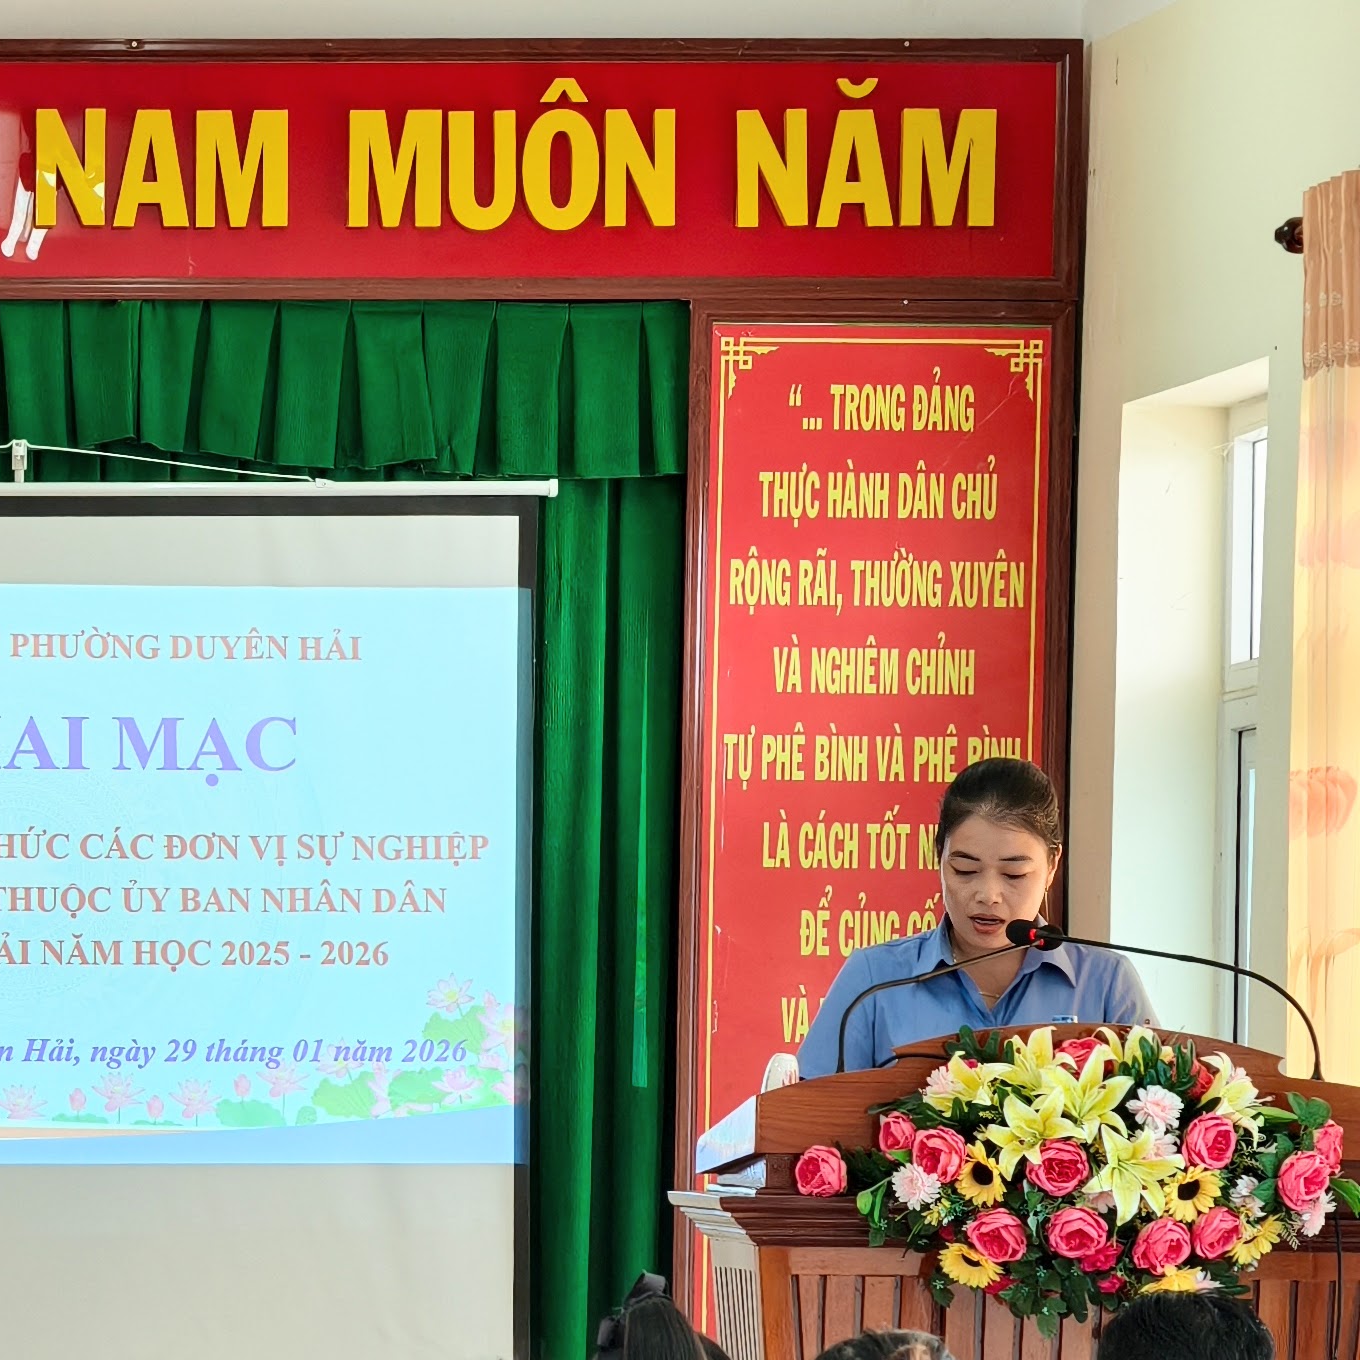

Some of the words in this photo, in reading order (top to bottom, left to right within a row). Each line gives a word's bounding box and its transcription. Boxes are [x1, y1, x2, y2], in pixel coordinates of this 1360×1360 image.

[36, 109, 288, 228] NAM
[349, 78, 676, 230] MUÔN
[737, 78, 998, 228] NĂM
[831, 384, 905, 431] TRONG
[913, 367, 974, 431] ĐẢNG
[759, 463, 820, 528] THỰC
[828, 459, 889, 518] HÀNH
[898, 460, 944, 518] DÂN
[952, 455, 997, 520] CHỦ
[730, 546, 791, 615] RỘNG
[798, 548, 842, 615] RÃI,
[851, 548, 942, 607] THƯỜNG
[949, 549, 1024, 608] XUYÊN
[10, 626, 160, 659] PHƯỜNG
[170, 627, 288, 660] DUYÊN
[298, 628, 362, 660] HẢI
[773, 634, 802, 693] VÀ
[811, 635, 899, 694] NGHIÊM
[906, 632, 975, 695] CHỈNH
[112, 717, 296, 786] MẠC
[724, 725, 755, 790] TỰ
[762, 722, 805, 780] PHÊ
[815, 723, 868, 781] BÌNH
[876, 723, 904, 781] VÀ
[914, 724, 957, 782] PHÊ
[80, 826, 153, 860] CÁC
[164, 832, 240, 860] ĐƠN
[248, 834, 287, 867] VỊ
[297, 831, 344, 866] SỰ
[352, 832, 489, 867] NGHIỆP
[763, 809, 790, 868] LÀ
[799, 810, 858, 869] CÁCH
[867, 805, 910, 870] TỐT
[121, 880, 171, 912] ỦY
[179, 887, 251, 912] BAN
[261, 879, 362, 913] NHÂN
[372, 880, 447, 913] DÂN
[800, 885, 832, 955] ĐỂ
[839, 892, 900, 957] CỦNG
[40, 933, 123, 965] NĂM
[132, 940, 211, 972] HỌC
[222, 941, 290, 966] 2025
[321, 941, 389, 966] 2026
[782, 985, 809, 1043] VÀ
[21, 1038, 80, 1066] Hải,
[90, 1039, 156, 1069] ngày
[164, 1039, 197, 1062] 29
[206, 1039, 284, 1069] tháng
[292, 1039, 323, 1063] 01
[333, 1038, 393, 1063] năm
[401, 1039, 467, 1063] 2026
